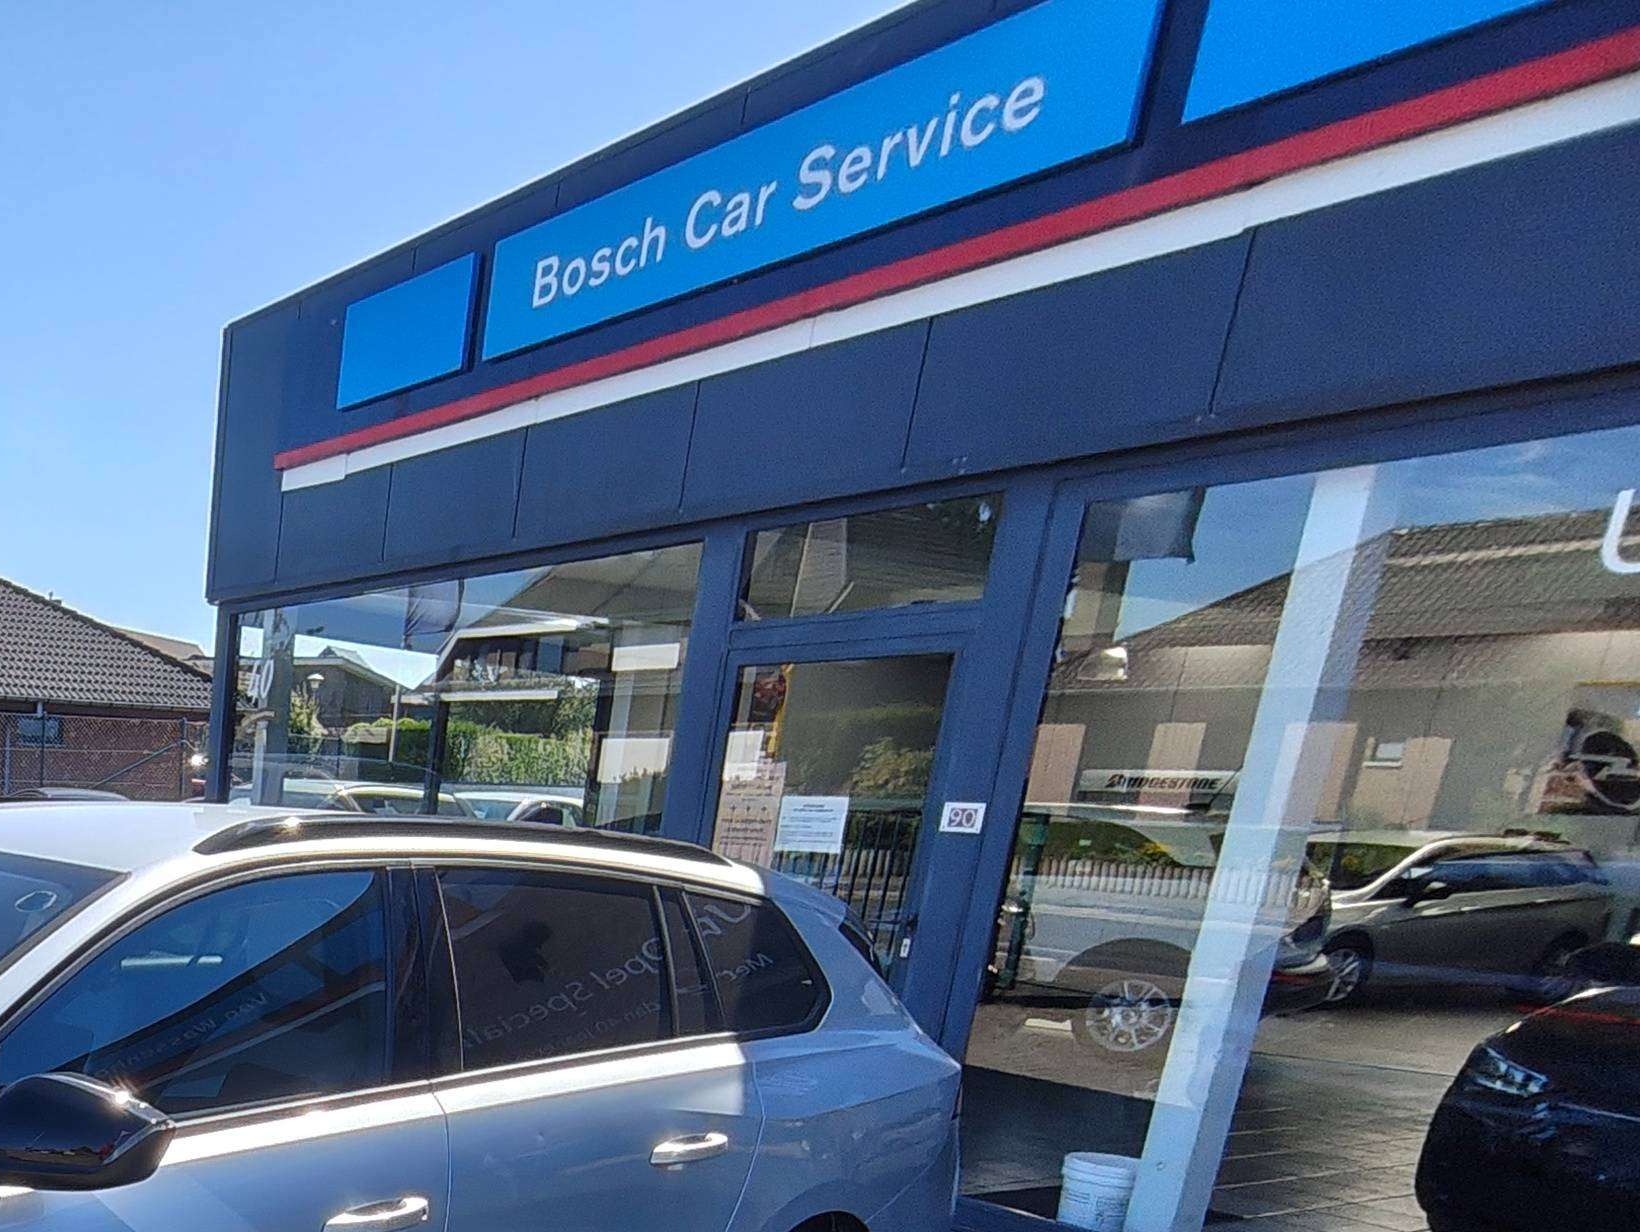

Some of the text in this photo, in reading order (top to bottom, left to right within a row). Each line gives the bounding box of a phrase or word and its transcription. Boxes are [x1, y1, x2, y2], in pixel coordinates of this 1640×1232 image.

[531, 75, 1046, 309] Bosch Car Service
[948, 808, 977, 828] 90
